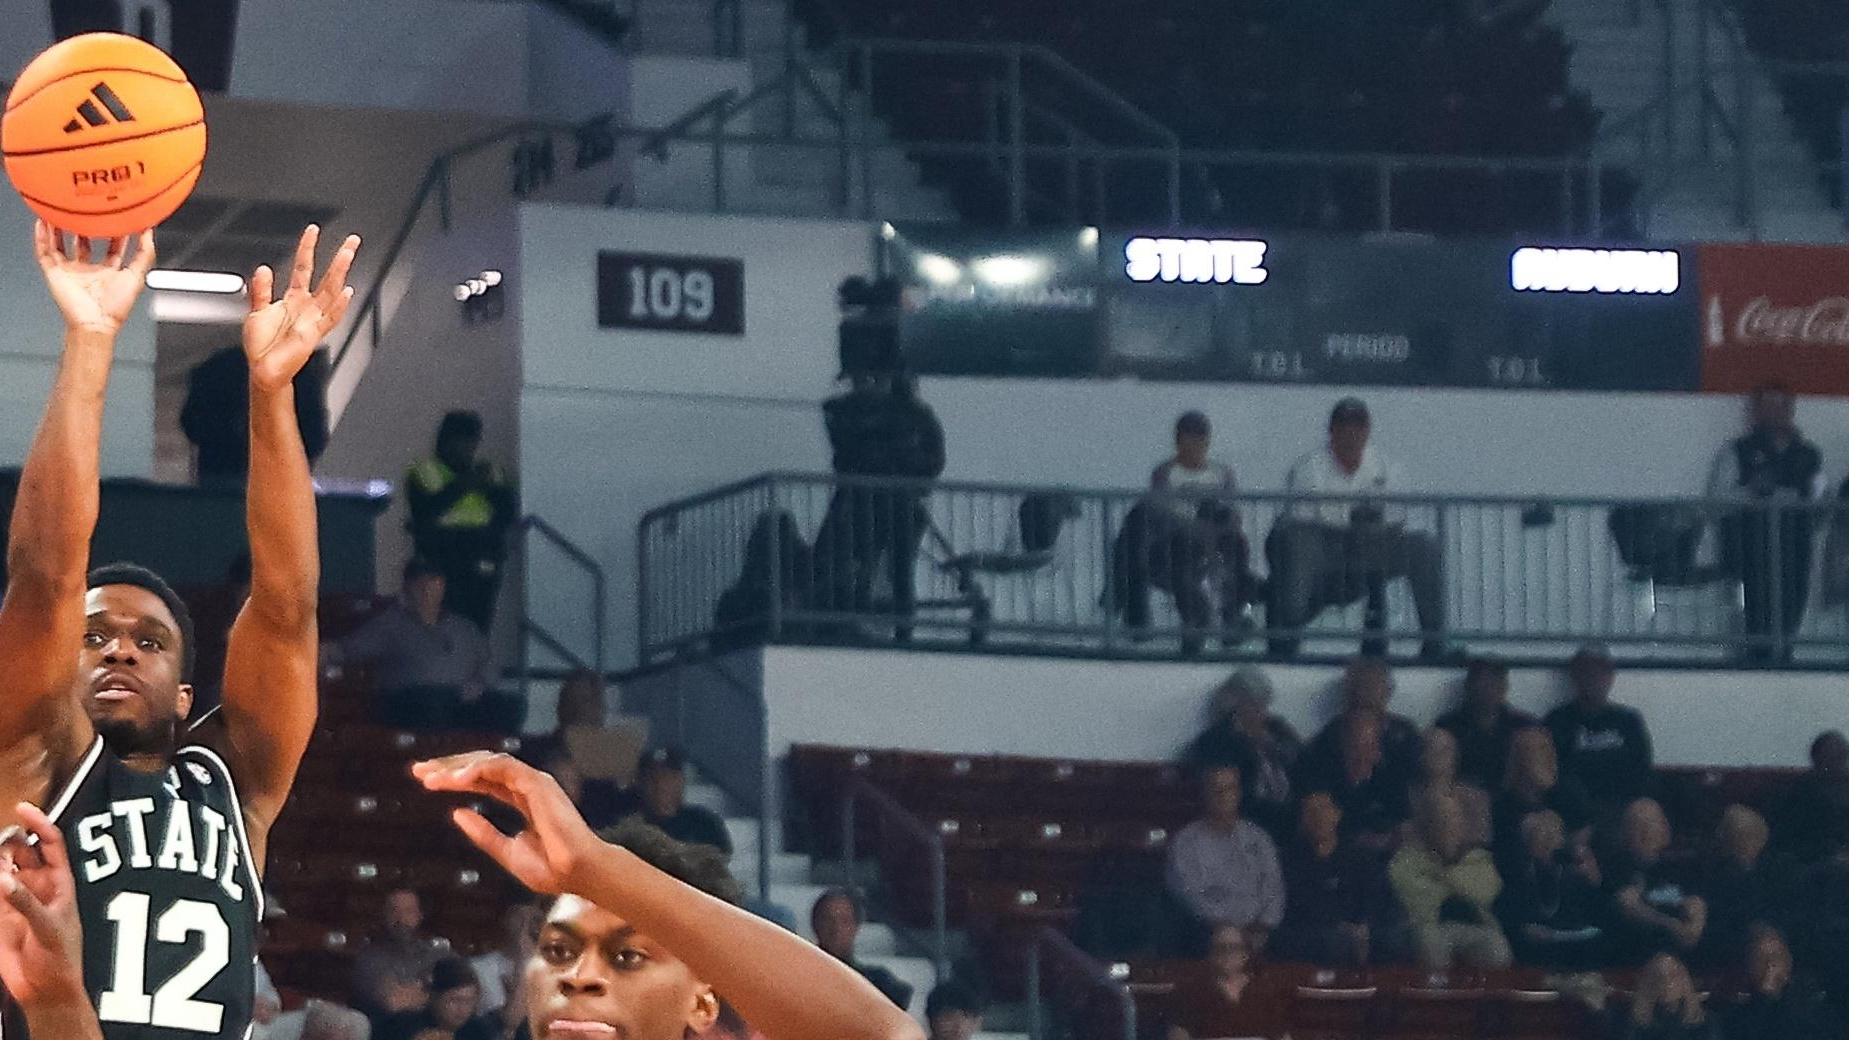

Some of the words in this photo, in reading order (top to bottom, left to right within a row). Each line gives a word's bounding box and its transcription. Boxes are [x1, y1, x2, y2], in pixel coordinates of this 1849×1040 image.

[629, 266, 715, 321] 109
[1125, 237, 1268, 284] STATE
[77, 797, 244, 901] STATE
[99, 891, 230, 1034] 12
